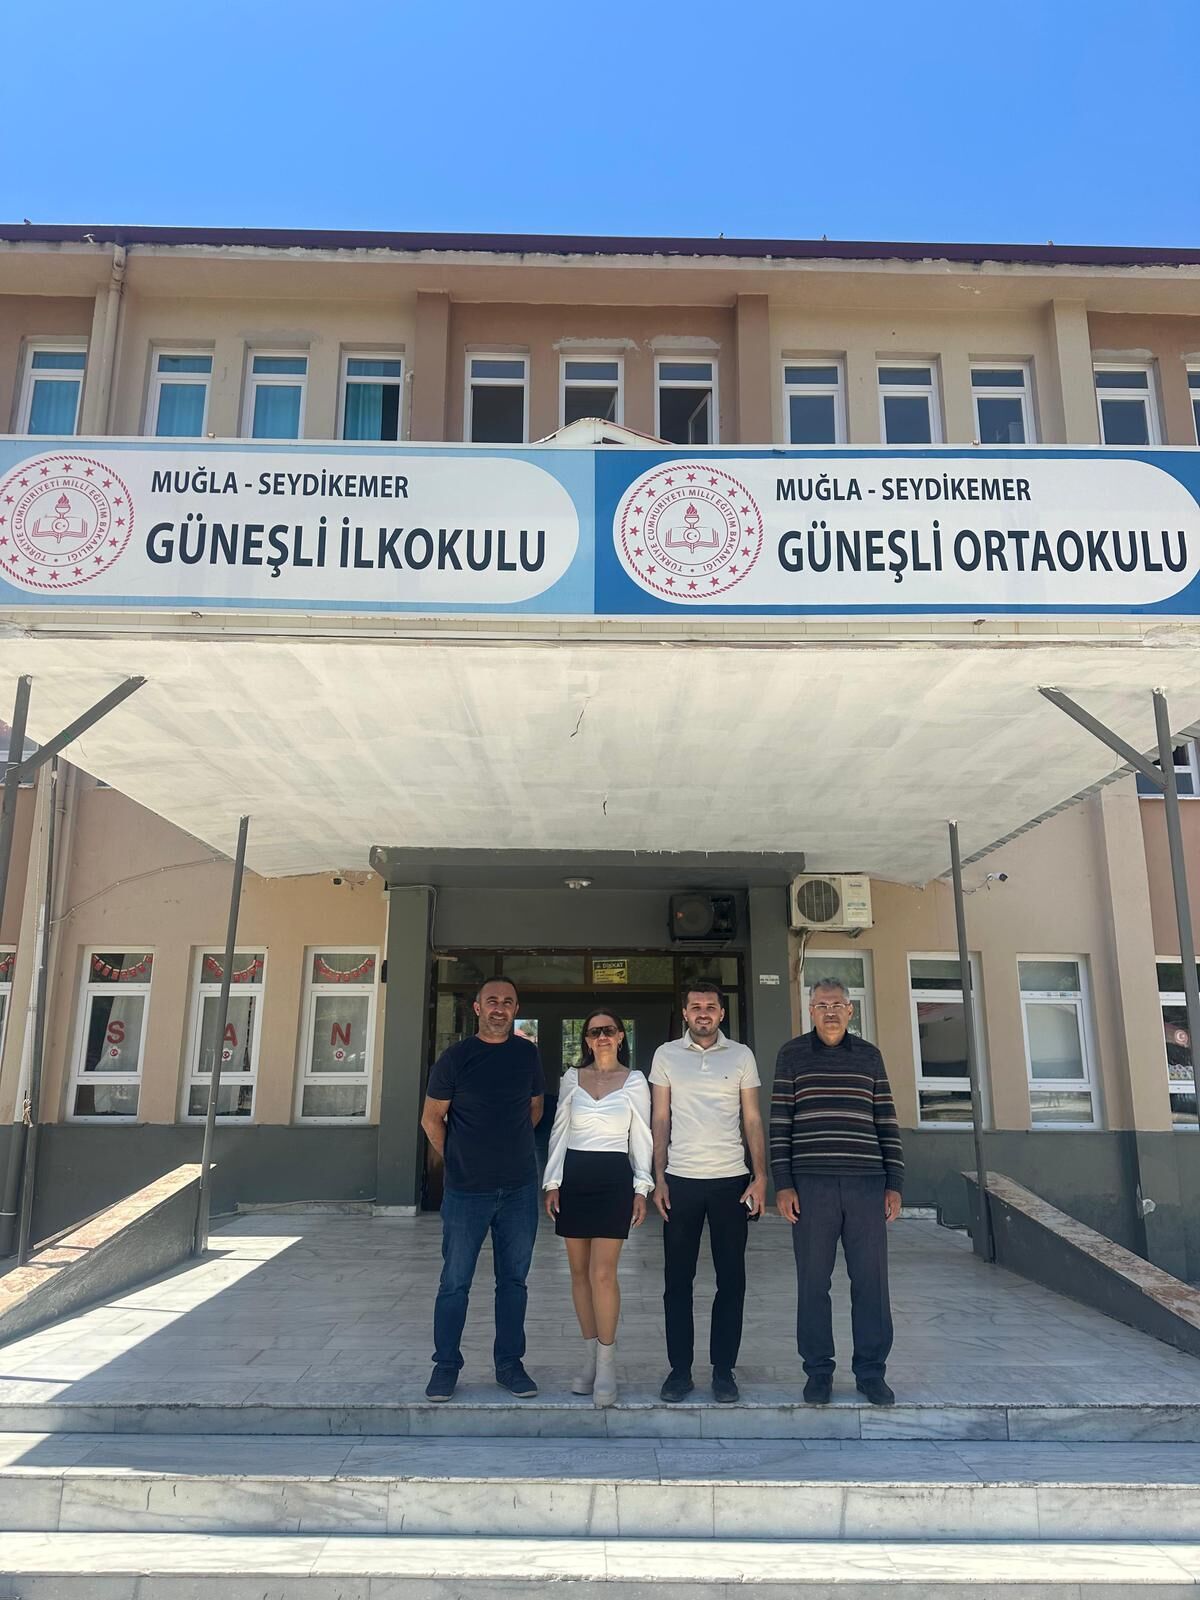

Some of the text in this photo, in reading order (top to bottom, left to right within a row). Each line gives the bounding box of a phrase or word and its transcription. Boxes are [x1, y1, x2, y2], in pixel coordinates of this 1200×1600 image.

[15, 479, 59, 530] CUMHURİYETİ
[89, 489, 107, 519] EĞİTİM
[152, 466, 238, 495] MUĞLA
[258, 469, 409, 499] SEYDİKEMER
[776, 474, 863, 501] MUĞLA
[882, 473, 1031, 501] SEYDİKEMER
[647, 489, 686, 541] CUMHURİYETİ
[715, 499, 736, 528] EĞİTİM
[146, 513, 546, 578] GÜNEŞLİ İLKOKULU
[777, 520, 1188, 584] GÜNEŞLİ ORTAOKULU
[106, 1020, 126, 1044] S
[330, 1022, 352, 1046] N
